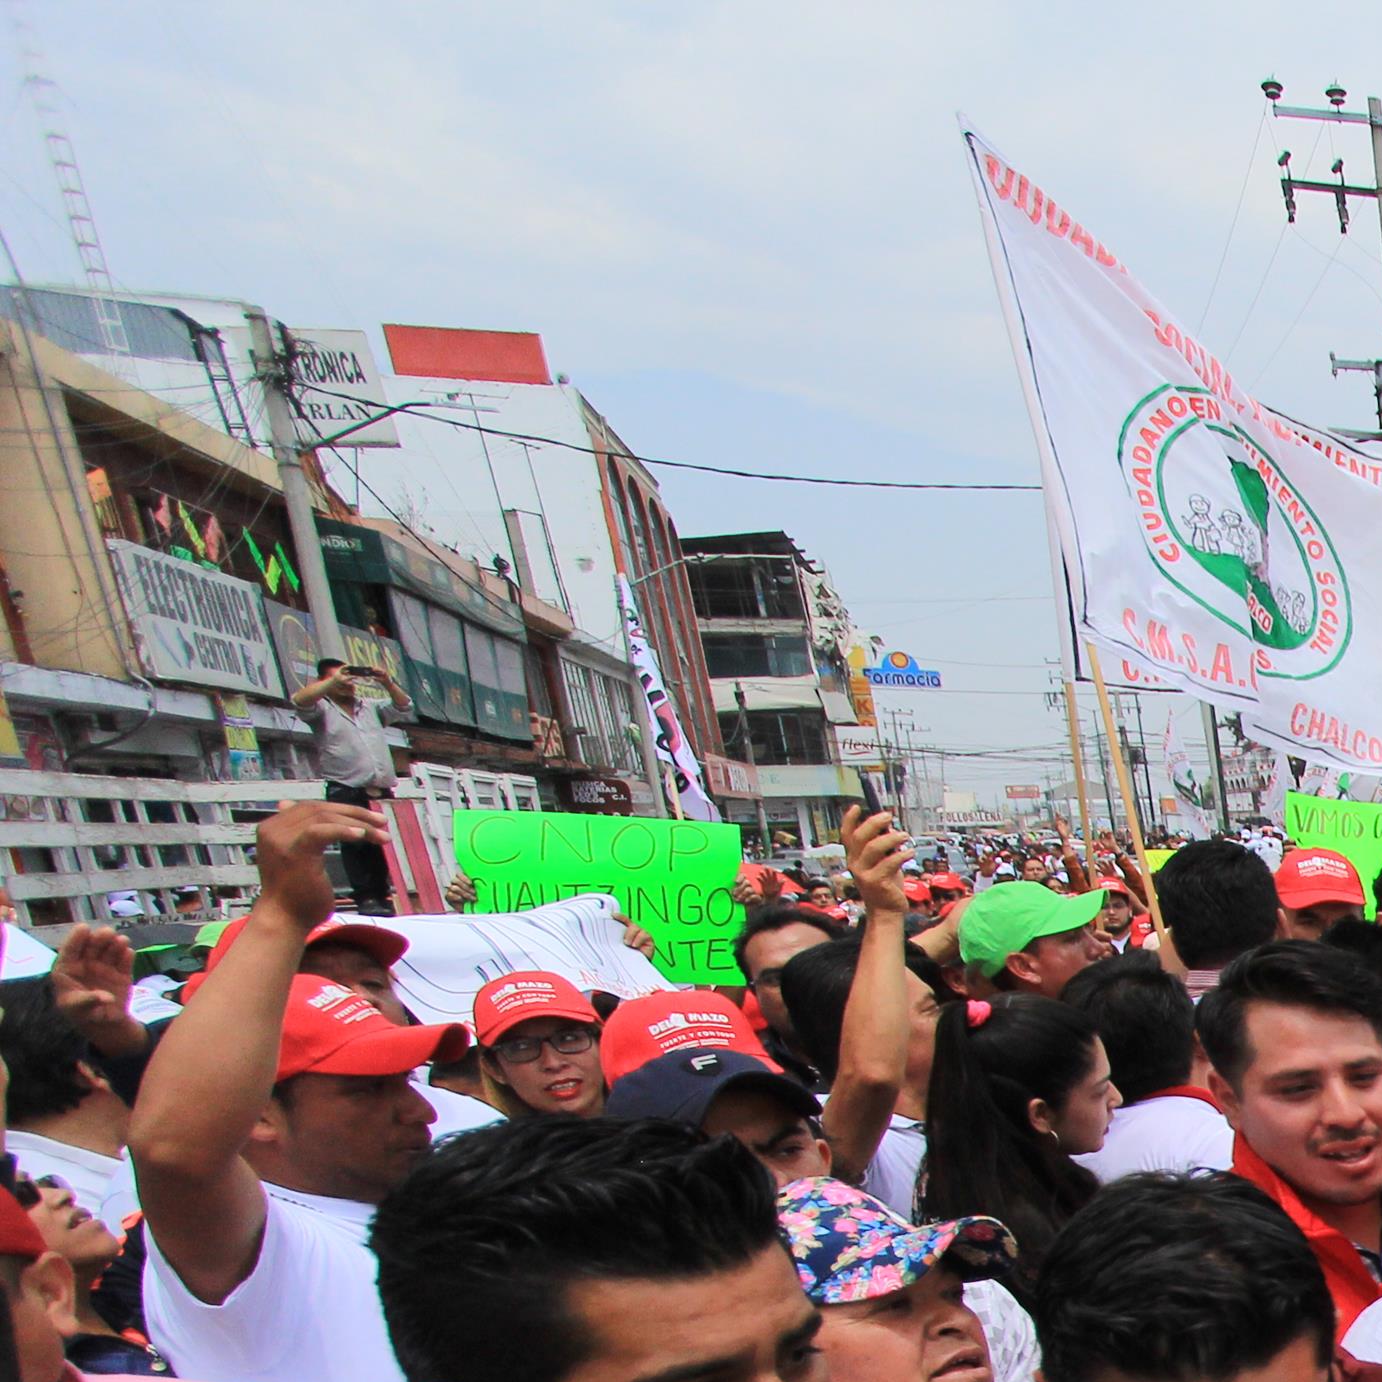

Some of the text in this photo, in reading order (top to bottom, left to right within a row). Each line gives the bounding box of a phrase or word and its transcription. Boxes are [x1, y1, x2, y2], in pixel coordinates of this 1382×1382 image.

[1132, 396, 1188, 563] CIUDADANO
[1188, 396, 1221, 421] EN
[320, 536, 356, 550] NDIO
[133, 552, 264, 645] ELECTRONICA
[1309, 571, 1339, 655] SOCIAL
[193, 631, 243, 676] CENTRO
[842, 738, 875, 751] flexi
[470, 816, 709, 872] CNOP
[1293, 804, 1365, 839] VAMOS
[648, 1013, 729, 1036] DEL MAZO
